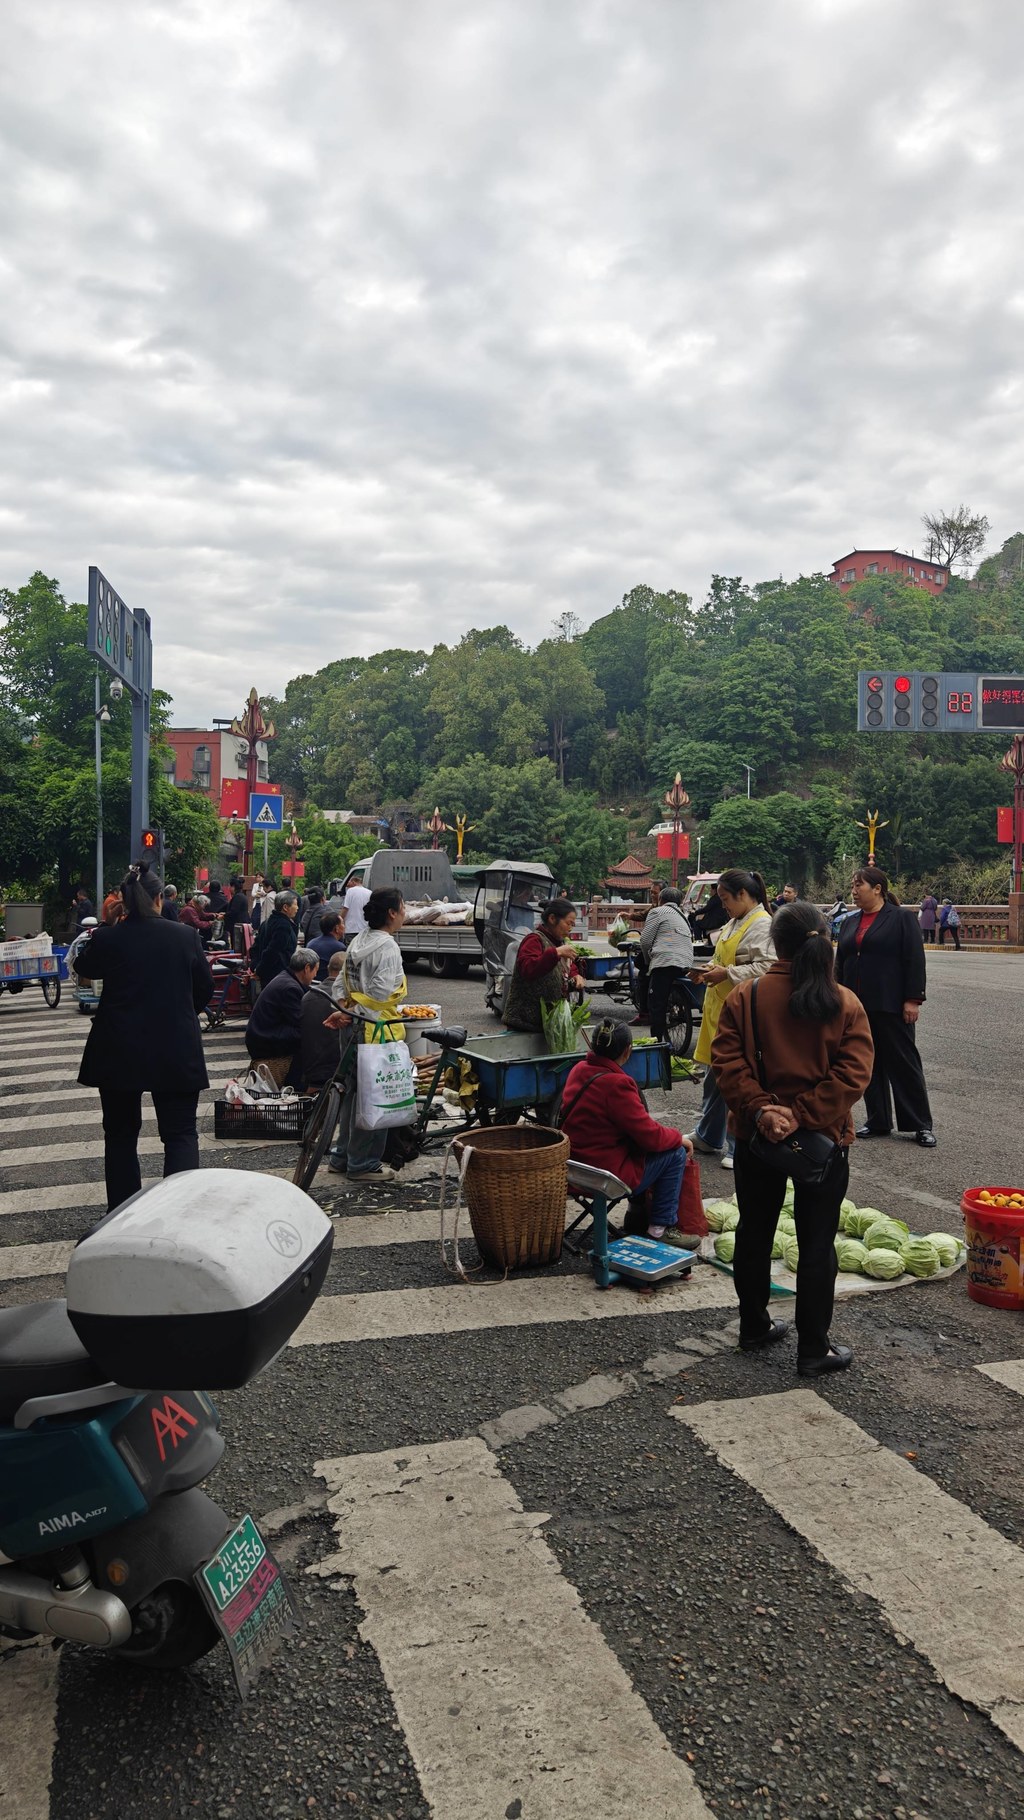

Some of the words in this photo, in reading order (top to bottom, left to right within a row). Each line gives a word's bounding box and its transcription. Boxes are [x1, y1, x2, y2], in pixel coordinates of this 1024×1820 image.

[948, 692, 972, 712] 22
[38, 1511, 87, 1536] AIMA
[85, 1507, 107, 1519] A107
[218, 1537, 262, 1602] A23556
